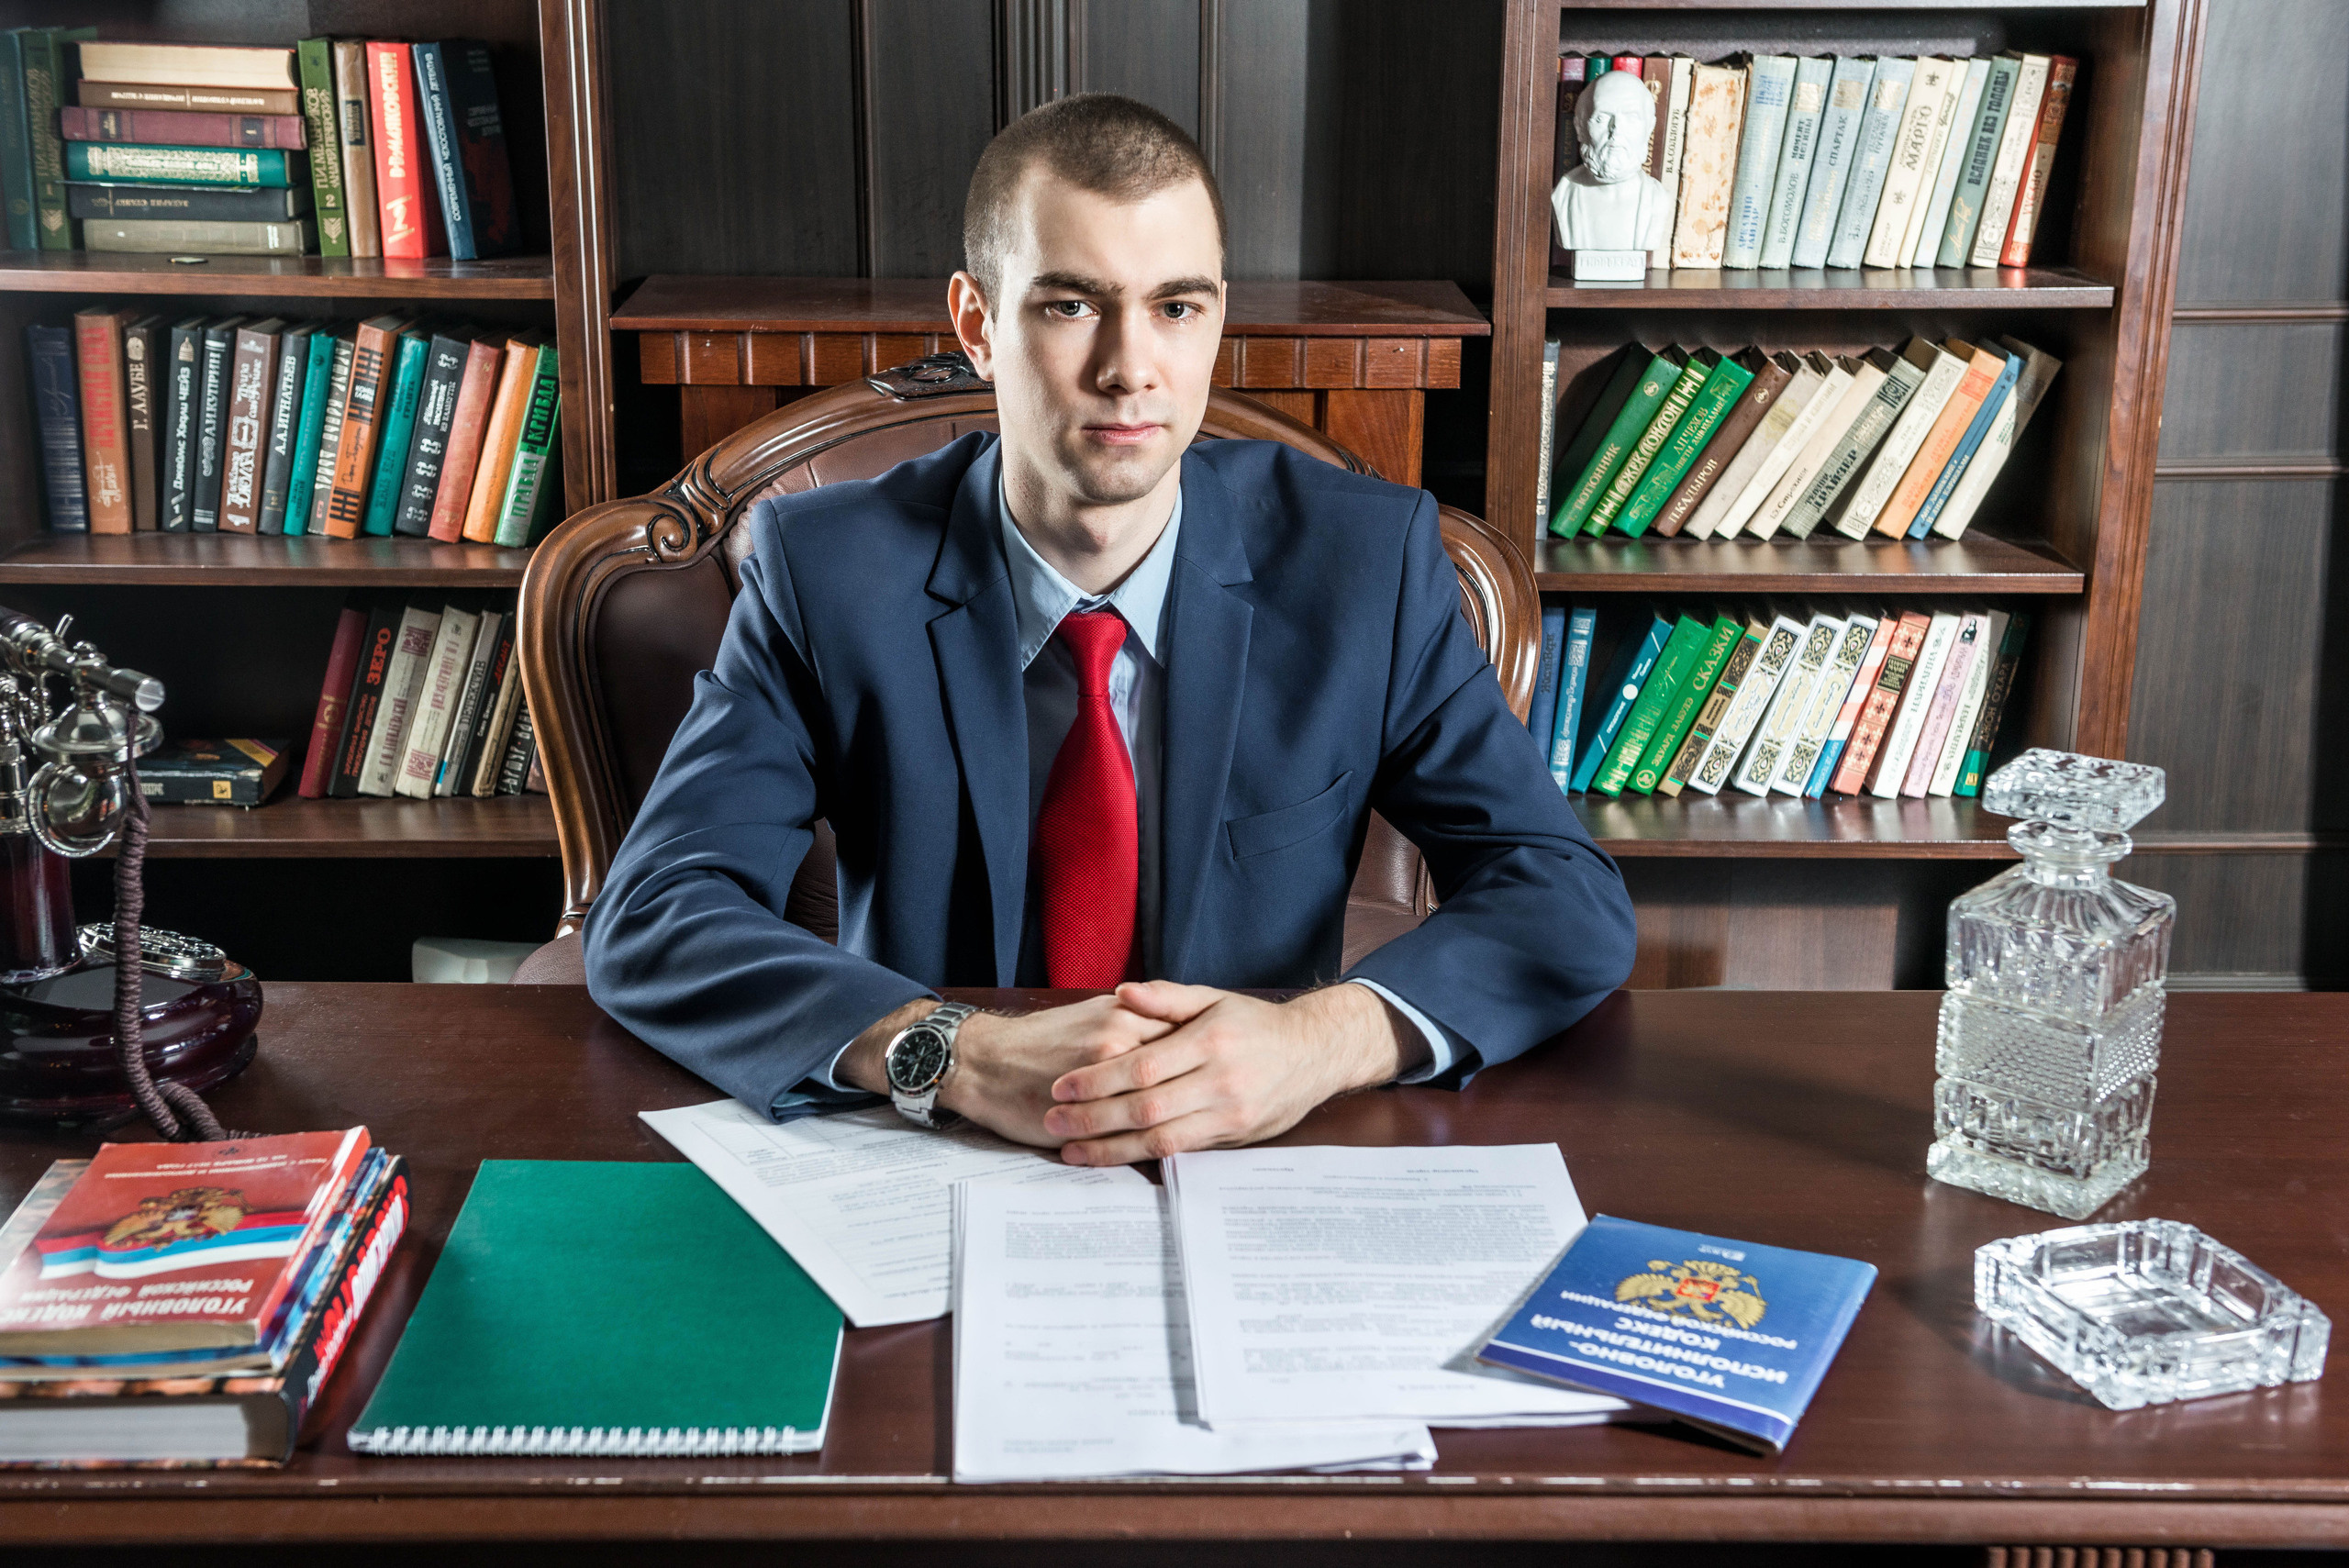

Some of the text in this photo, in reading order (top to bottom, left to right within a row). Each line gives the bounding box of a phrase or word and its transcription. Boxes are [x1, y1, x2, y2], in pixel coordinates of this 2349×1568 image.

[425, 53, 440, 92] ДЕТЕКТИВ
[1791, 119, 1805, 159] МОМЕНТ
[1828, 115, 1847, 167] СПАРТАК
[1905, 104, 1933, 172] МАРГО
[1967, 70, 2010, 186] ВСАДНИК БЕЗ ГОЛОВЫ
[442, 163, 462, 221] СОВРЕМЕННЫЙ
[129, 363, 149, 415] ЛАУБЕ
[175, 366, 192, 401] ЧЕЙЗ
[274, 355, 296, 455] А.А.ИГНАТЬЕВ
[176, 402, 189, 439] Хэдли
[509, 457, 540, 518] ПРАВДА
[527, 376, 558, 443] КРИВДА
[1611, 399, 1684, 496] ДЖЕК ЛОНДОН
[172, 440, 187, 491] Джеймс
[1572, 442, 1621, 511] ТЮТЮННИК
[1668, 456, 1720, 525] П.КАДЫРОВ
[1811, 448, 1860, 514] ДРАЙЗЕР
[363, 626, 395, 686] ЗЕРО
[1651, 626, 1735, 768] ЭДУАРД ЛАБУЛЭ СКАЗКИ
[1978, 706, 1999, 744] ДЖОН
[19, 1279, 254, 1303] РОССИЙСКОЙ ФЕДЕРАЦИИ
[100, 1296, 250, 1320] УГОЛОВНЫЙ
[1560, 1290, 1798, 1350] РОССИЙСКОЙ ФЕДЕРАЦИИ
[1530, 1314, 1788, 1385] ИСПОЛНИТЕЛЬНЫЙ
[1614, 1317, 1720, 1351] КОДЕКС
[1569, 1340, 1724, 1388] УГОЛОВНО-
